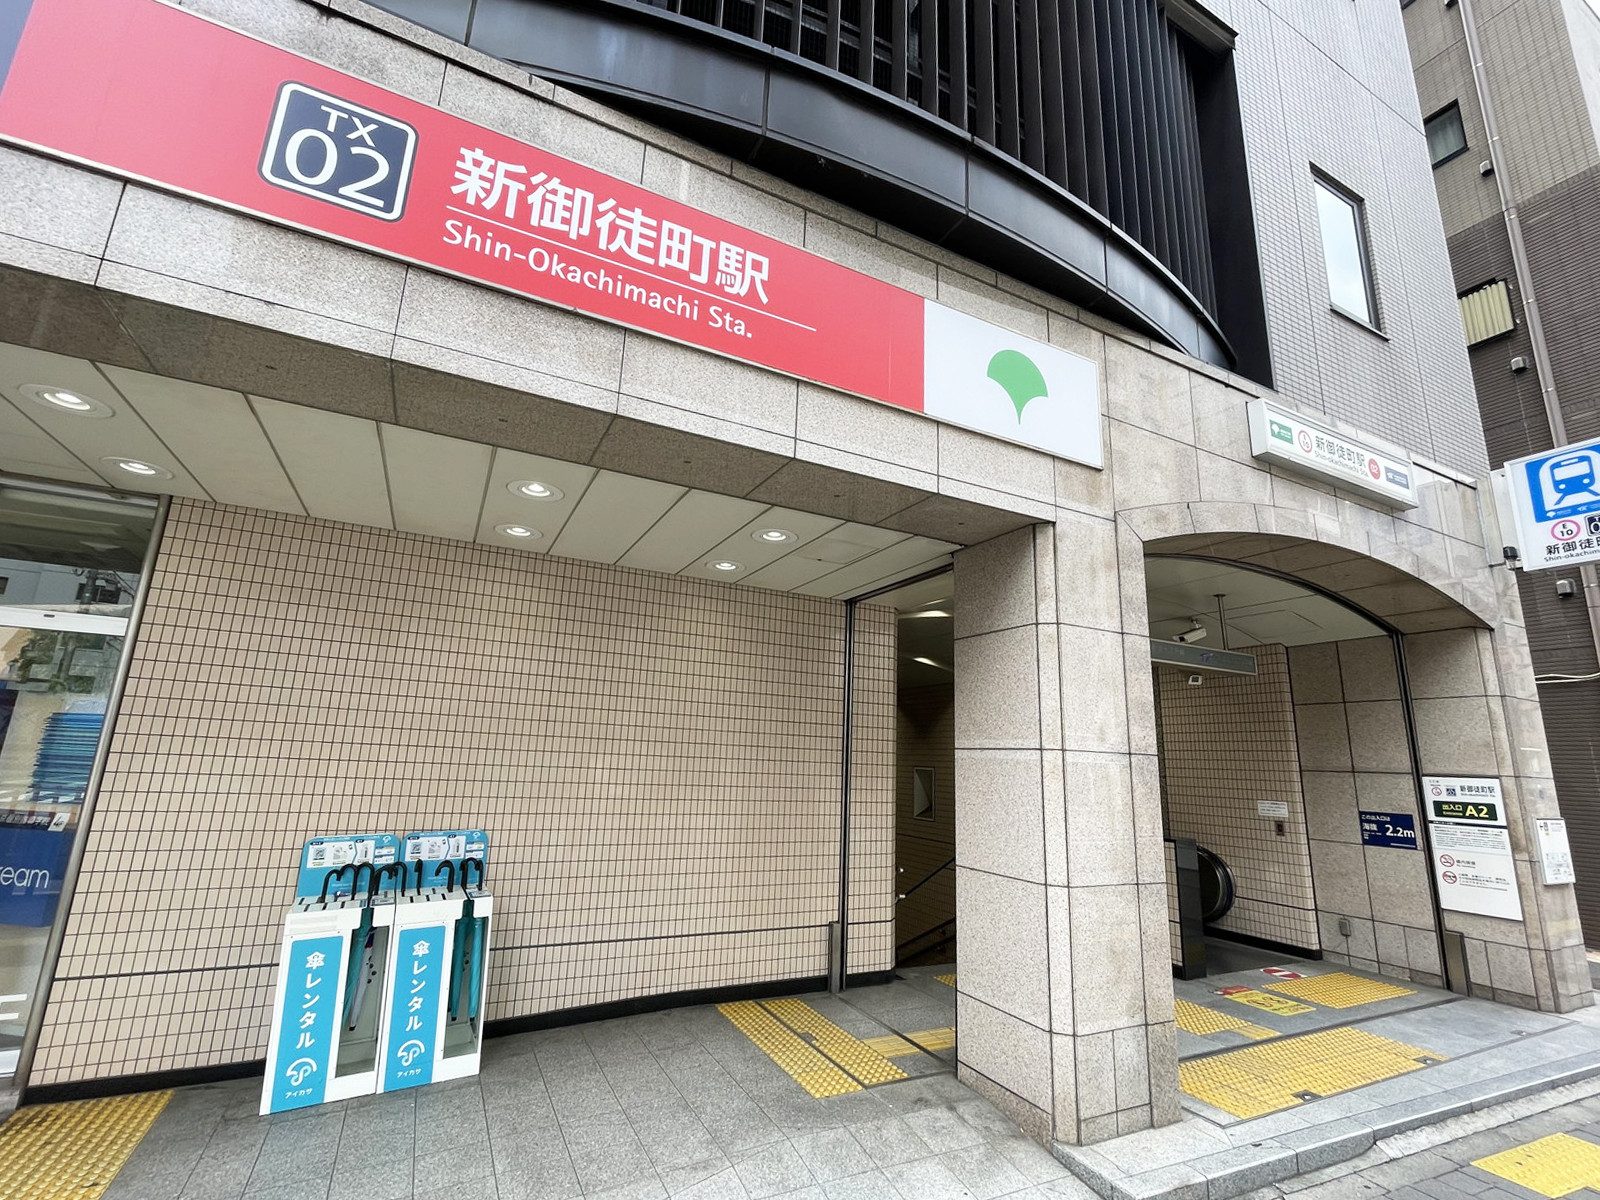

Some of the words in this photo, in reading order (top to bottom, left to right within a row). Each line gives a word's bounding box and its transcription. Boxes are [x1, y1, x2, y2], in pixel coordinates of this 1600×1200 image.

[320, 104, 379, 148] TX
[285, 128, 390, 208] 02
[449, 146, 770, 305] 新御徒町駅
[442, 218, 699, 321] Shin-Okachimachi
[707, 305, 753, 339] Sta.
[1314, 434, 1367, 469] 新御徒町駅
[1560, 529, 1573, 537] 10
[1465, 804, 1489, 818] A2
[1384, 824, 1415, 838] 2.2m
[0, 866, 50, 889] eam
[295, 951, 326, 1050] 傘レンタル
[405, 940, 431, 1032] 傘レンタル
[396, 1068, 422, 1078] アイカサ
[285, 1088, 313, 1099] アイカサ
